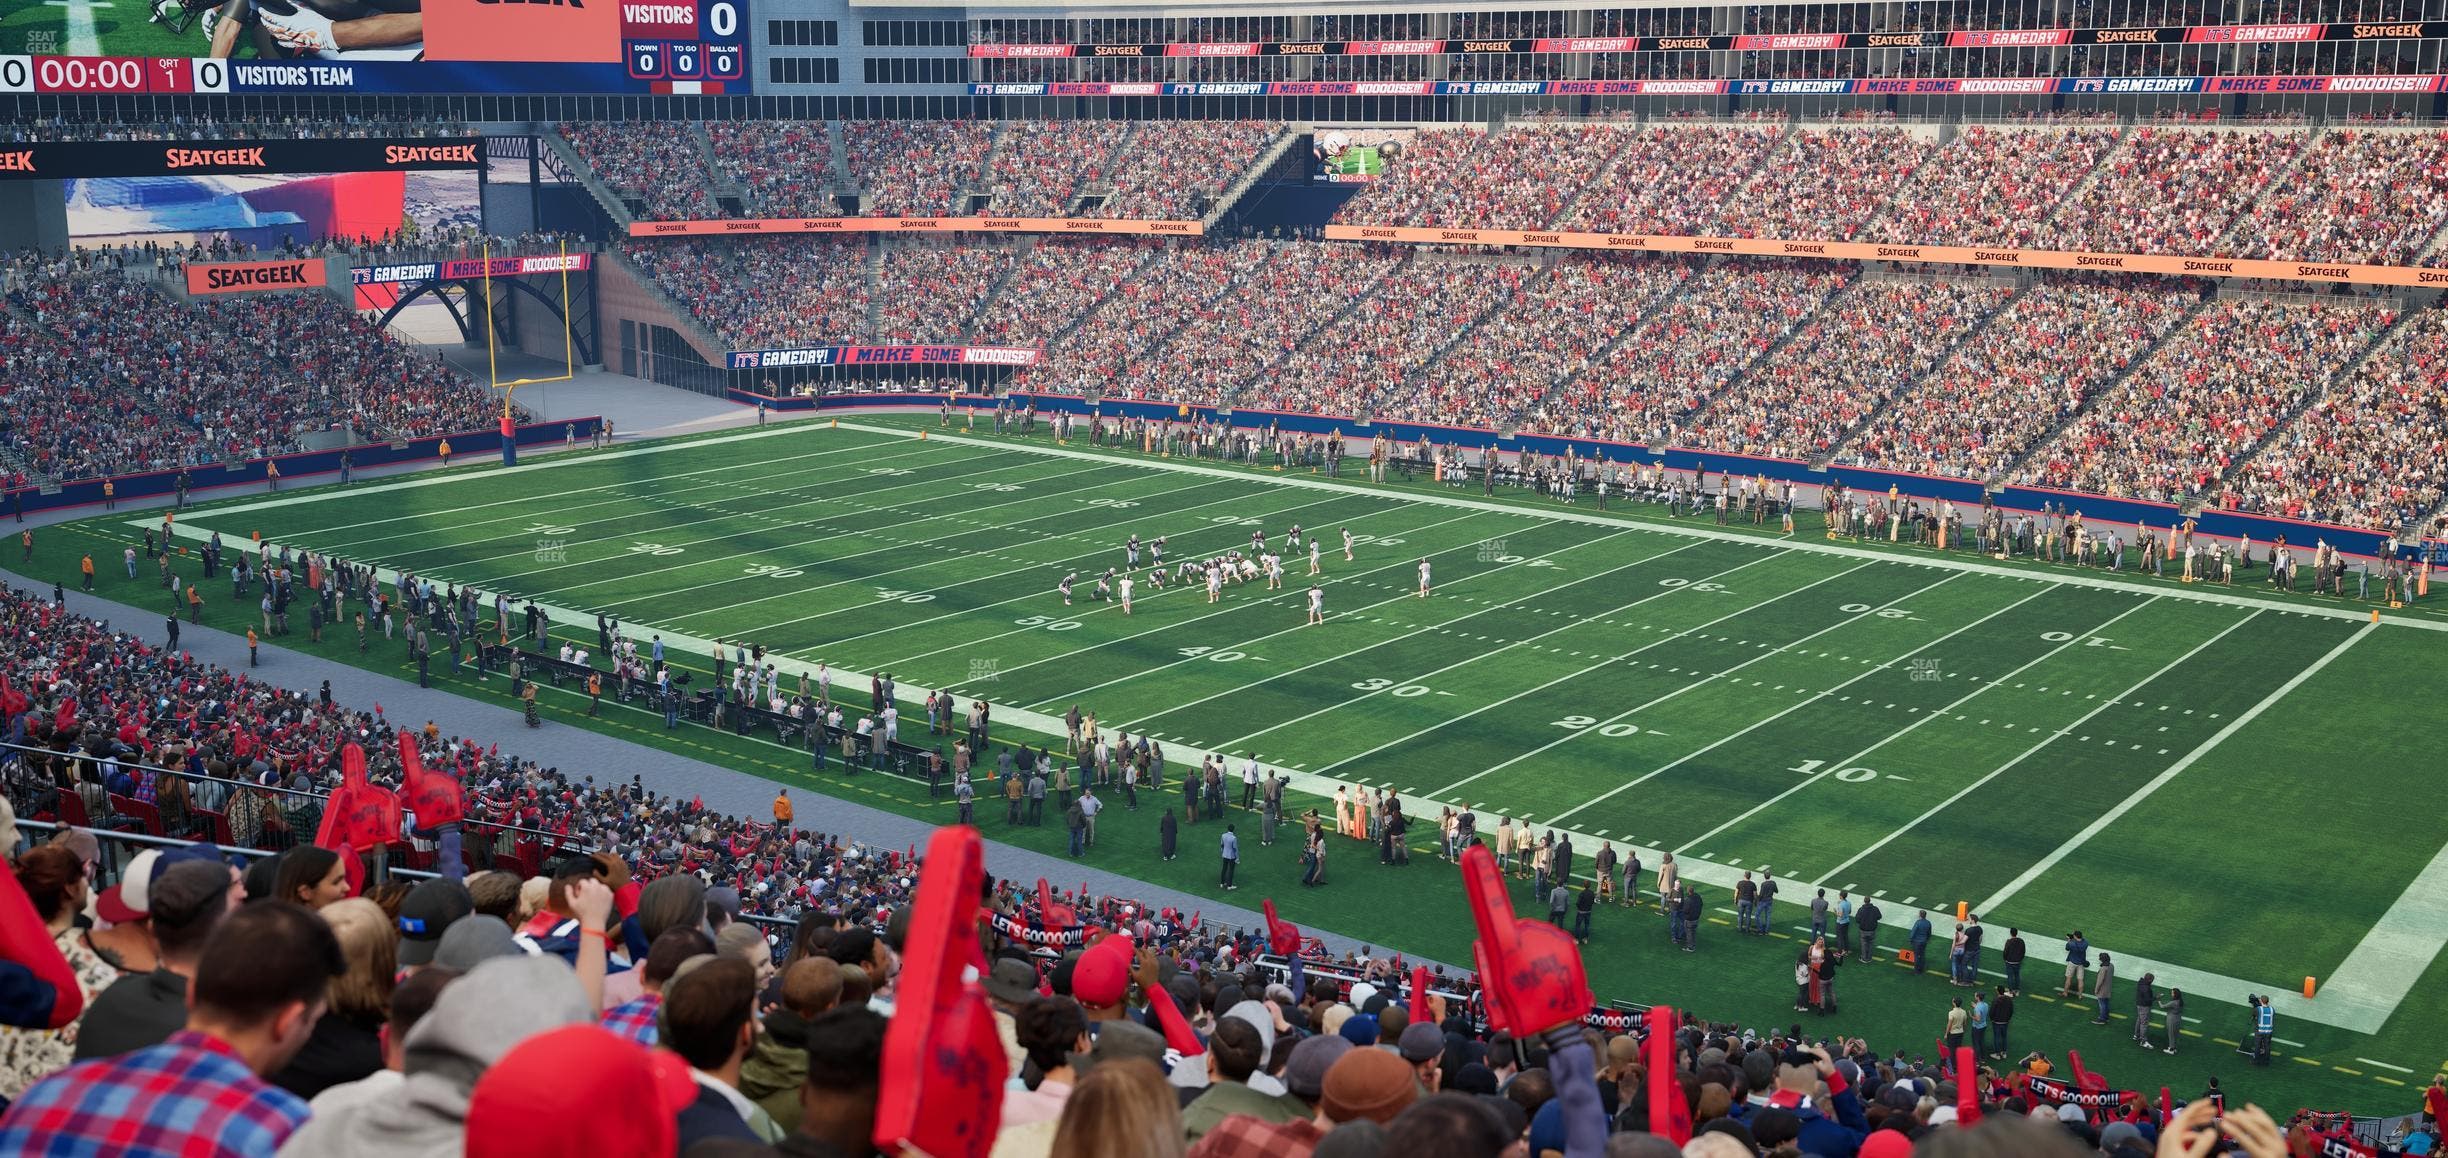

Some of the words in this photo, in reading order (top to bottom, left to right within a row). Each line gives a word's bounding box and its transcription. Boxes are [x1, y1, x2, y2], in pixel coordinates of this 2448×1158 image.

[624, 4, 693, 24] VISITORS
[711, 3, 736, 36] 0
[2097, 30, 2158, 42] SEATGEEK
[2205, 29, 2231, 40] IT'S
[2235, 27, 2310, 40] GAMEDAY!
[2354, 24, 2422, 38] SEATGEEK
[1658, 38, 1710, 49] SEATGEEK
[1748, 38, 1769, 48] IT'S
[1772, 36, 1834, 48] GAMEDAY!
[1868, 34, 1922, 46] SEATGEEK
[1964, 34, 1988, 44] IT'S
[1992, 32, 2058, 44] GAMEDAY!
[1200, 45, 1250, 55] GAMEDAY!
[1280, 44, 1324, 54] SEATGEEK
[1359, 44, 1378, 53] IT'S
[1380, 42, 1434, 53] GAMEDAY!
[1464, 42, 1511, 52] SEATGEEK
[1548, 41, 1568, 50] IT'S
[1570, 40, 1627, 50] GAMEDAY!
[1008, 46, 1064, 56] GAMEDAY!
[1095, 46, 1143, 56] SEATGEEK
[160, 59, 178, 68] QRT
[640, 54, 653, 71] 0
[679, 55, 692, 72] 0
[718, 56, 731, 72] 0
[4, 60, 26, 87] 0
[40, 60, 141, 88] 00:00
[166, 70, 174, 88] 1
[200, 62, 222, 88] 0
[235, 66, 308, 86] VISITORS
[310, 67, 353, 86] TEAM
[975, 85, 994, 94] IT'S
[995, 85, 1044, 94] GAMEDAY!
[1058, 85, 1082, 94] MAKE
[1086, 85, 1108, 94] SOME
[1174, 84, 1196, 94] IT'S
[1198, 84, 1262, 94] GAMEDAY!
[1280, 84, 1314, 94] MAKE
[1320, 84, 1352, 94] SOME
[1447, 83, 1471, 94] IT'S
[1474, 83, 1540, 94] GAMEDAY!
[1560, 83, 1598, 92] MAKE
[1602, 82, 1639, 92] SOME
[1741, 82, 1768, 92] IT'S
[1770, 81, 1846, 92] GAMEDAY!
[1866, 81, 1908, 92] MAKE
[1916, 81, 1956, 91] SOME
[2074, 80, 2104, 91] IT'S
[2108, 79, 2194, 91] GAMEDAY!
[2218, 79, 2270, 90] MAKE
[2276, 79, 2325, 90] SOME
[166, 147, 266, 168] SEATGEEK
[386, 144, 478, 164] SEATGEEK
[656, 225, 687, 234] SEATGEEK
[726, 222, 760, 230] SEATGEEK
[900, 220, 936, 228] SEATGEEK
[1150, 224, 1188, 232] SEATGEEK
[1362, 230, 1396, 238] SEATGEEK
[1442, 232, 1478, 240] SEATGEEK
[1523, 234, 1560, 244] SEATGEEK
[1608, 237, 1645, 246] SEATGEEK
[1694, 240, 1733, 251] SEATGEEK
[1784, 244, 1824, 254] SEATGEEK
[1878, 248, 1920, 258] SEATGEEK
[1974, 252, 2018, 262] SEATGEEK
[2077, 256, 2122, 267] SEATGEEK
[453, 262, 485, 276] MAKE
[490, 260, 519, 274] SOME
[2184, 261, 2232, 272] SEATGEEK
[2298, 266, 2350, 278] SEATGEEK
[208, 264, 306, 289] SEATGEEK
[374, 264, 435, 281] GAMEDAY!
[735, 353, 758, 368] IT'S
[762, 349, 828, 366] GAMEDAY!
[856, 348, 914, 362] MAKE
[922, 348, 960, 362] SOME
[1014, 615, 1082, 631] 50
[1178, 646, 1246, 662] 40
[1351, 678, 1430, 697] 30
[1550, 715, 1639, 736] 20
[1787, 760, 1877, 782] 10
[992, 914, 1021, 937] LET'S
[1022, 928, 1083, 944] GOOOOO!!!
[2030, 1078, 2058, 1098] LET'S
[2059, 1092, 2119, 1106] GOOOOO!!!
